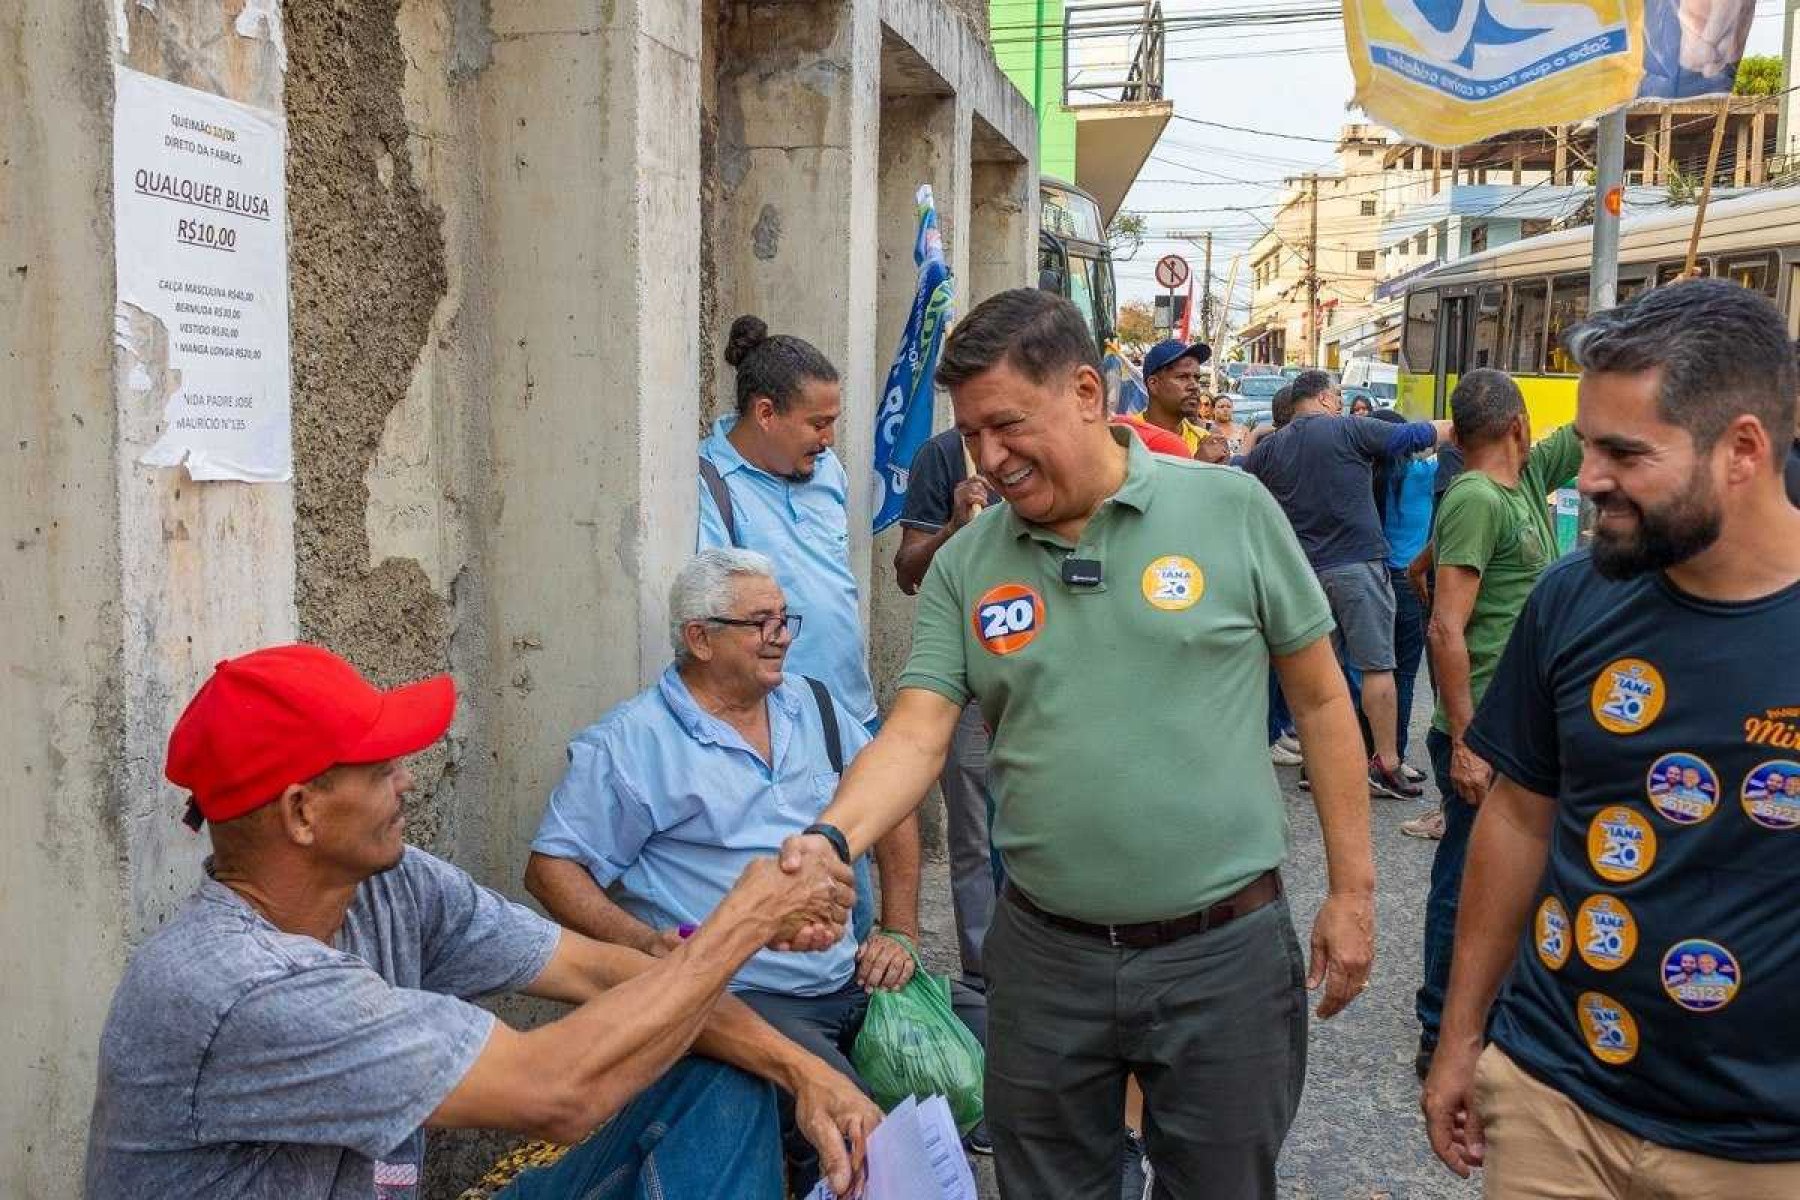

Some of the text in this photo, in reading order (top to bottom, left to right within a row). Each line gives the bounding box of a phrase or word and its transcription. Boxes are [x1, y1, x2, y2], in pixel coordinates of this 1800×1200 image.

[164, 134, 196, 153] DIRETO
[197, 144, 209, 157] DA
[134, 168, 270, 216] QUALQUER BLUSA
[177, 218, 237, 247] R$10,00
[175, 302, 213, 316] BERMUDA
[179, 323, 211, 337] VESTIDO
[179, 343, 209, 357] MANGA
[980, 599, 1034, 640] 20
[1601, 690, 1642, 720] 20
[1598, 843, 1640, 867] 20
[1585, 931, 1621, 955] 20
